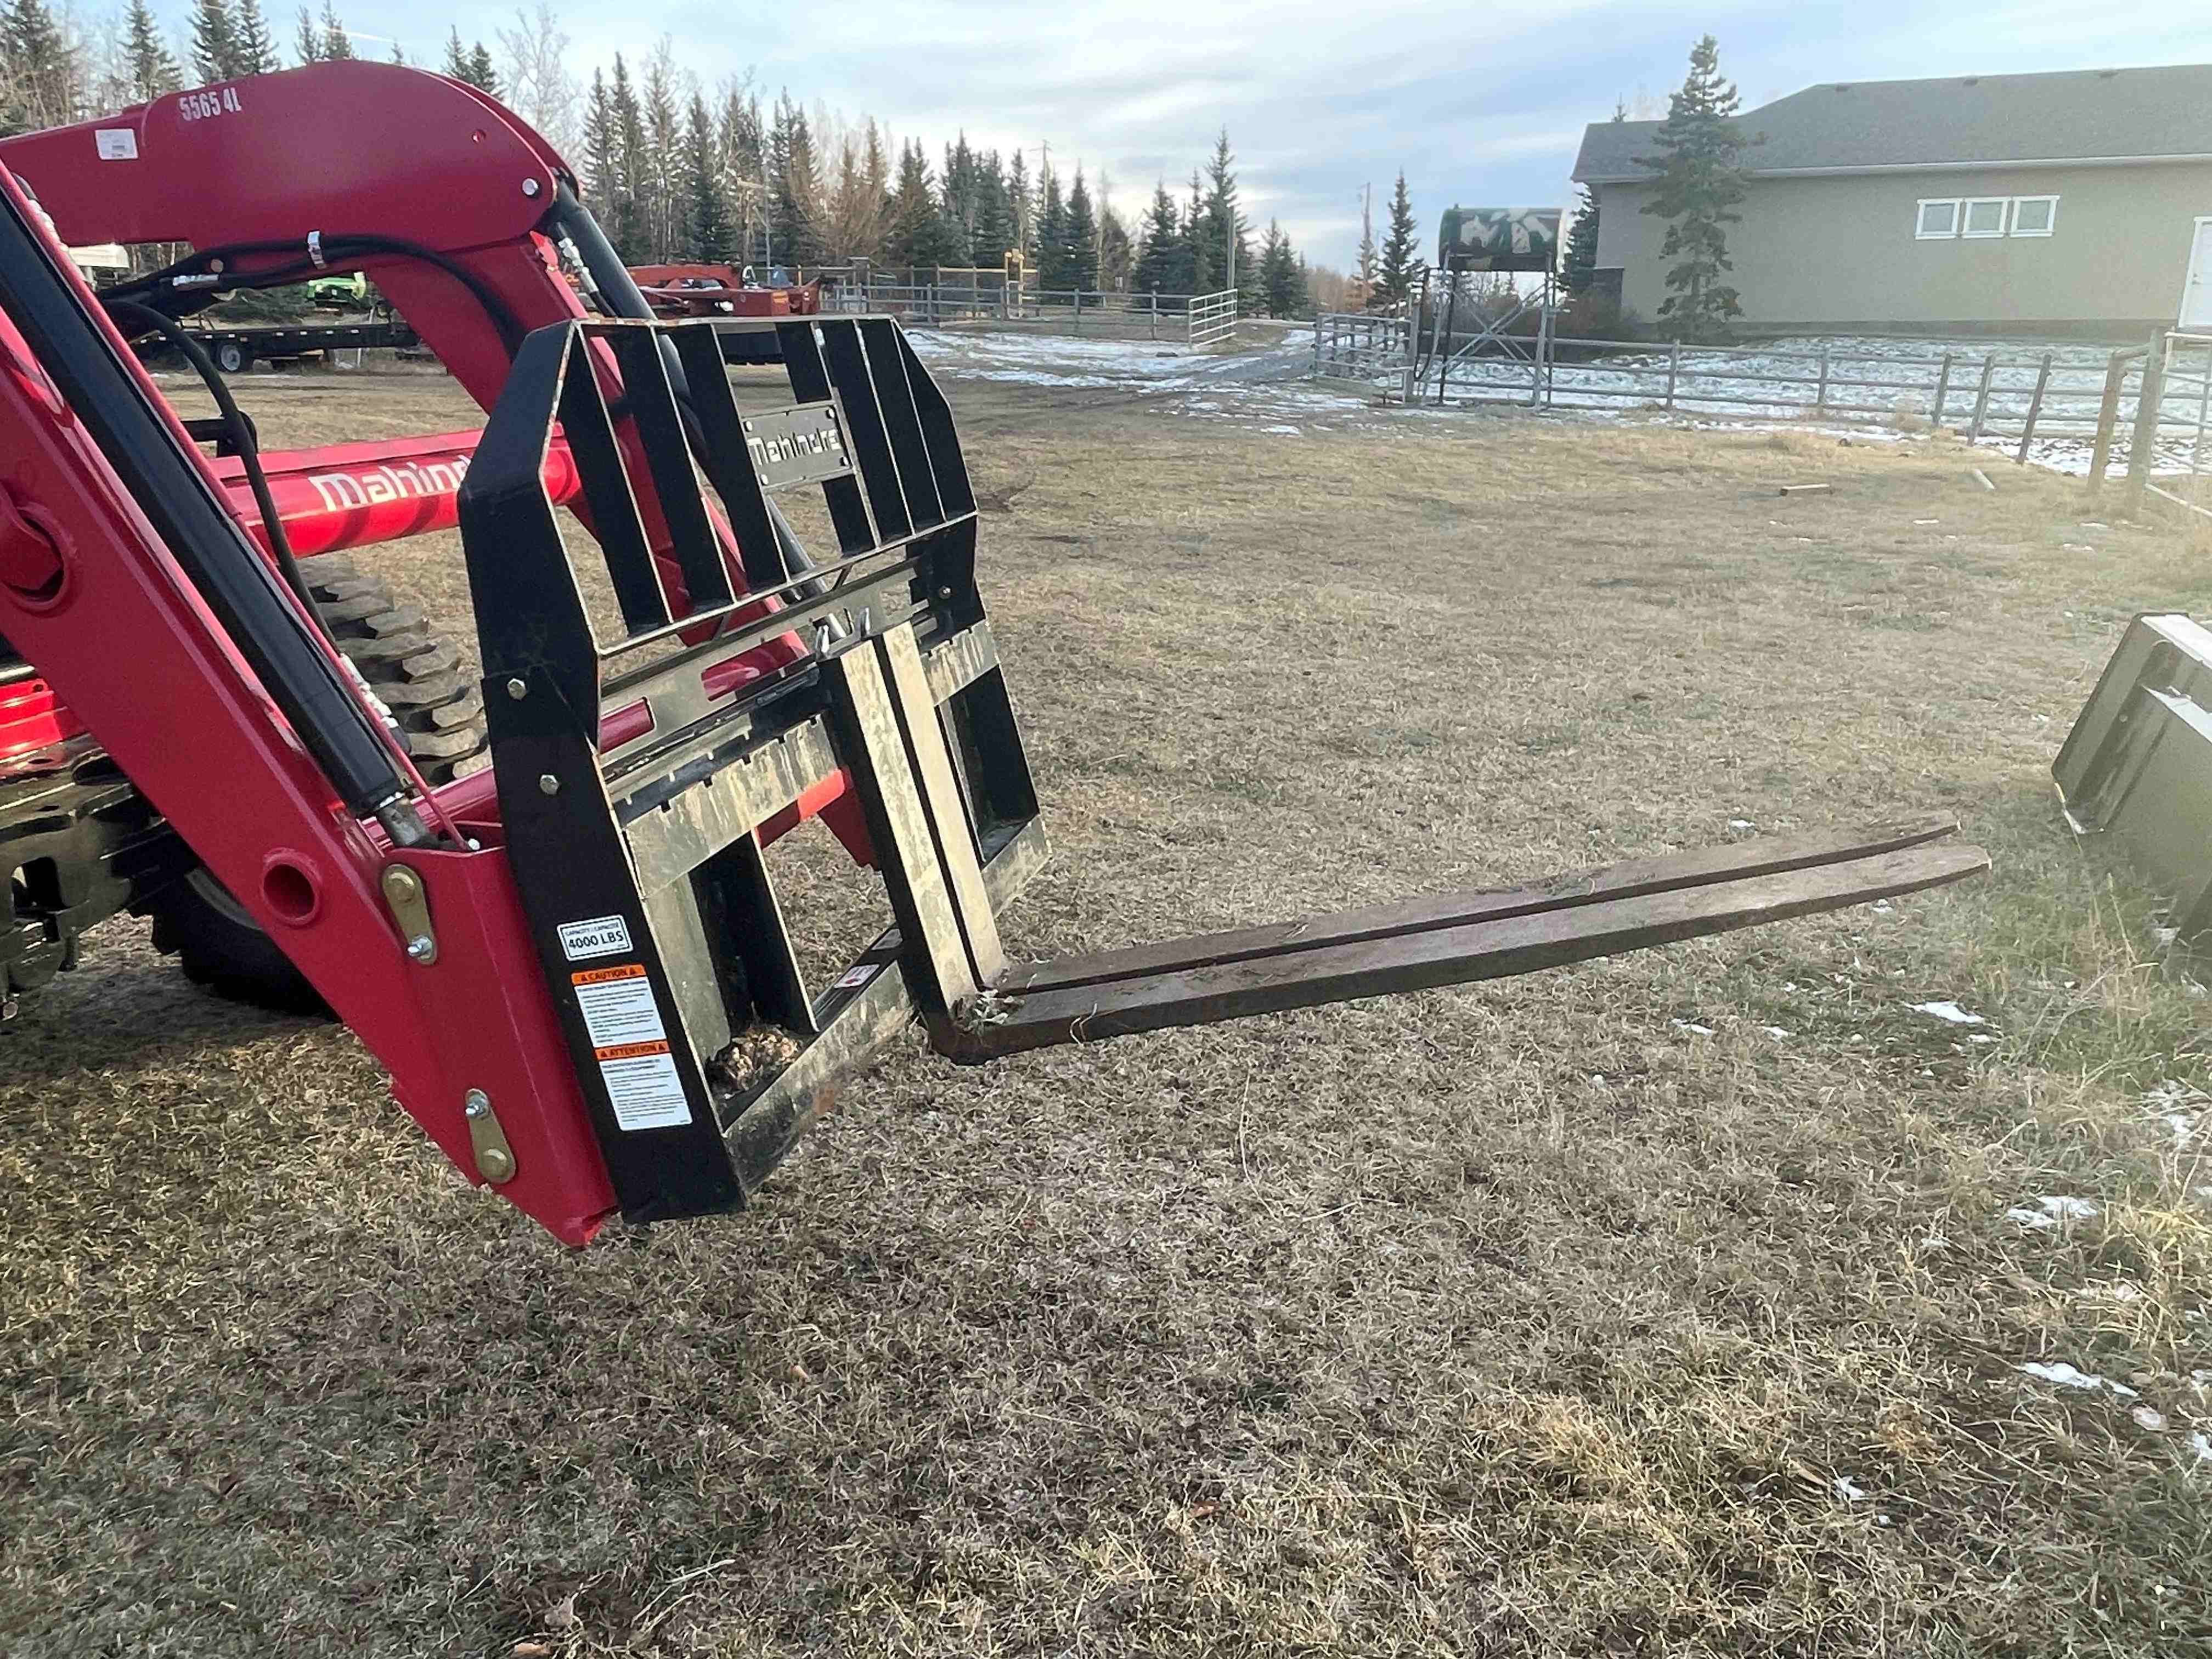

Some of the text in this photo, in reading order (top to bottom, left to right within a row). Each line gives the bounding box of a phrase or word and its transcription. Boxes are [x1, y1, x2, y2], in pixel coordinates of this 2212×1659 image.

[178, 87, 242, 121] 5565 4L
[746, 428, 842, 466] Mahindra
[569, 930, 623, 948] 4000 LBS
[587, 968, 627, 980] CAUTION
[609, 1044, 657, 1056] ATTENTION
